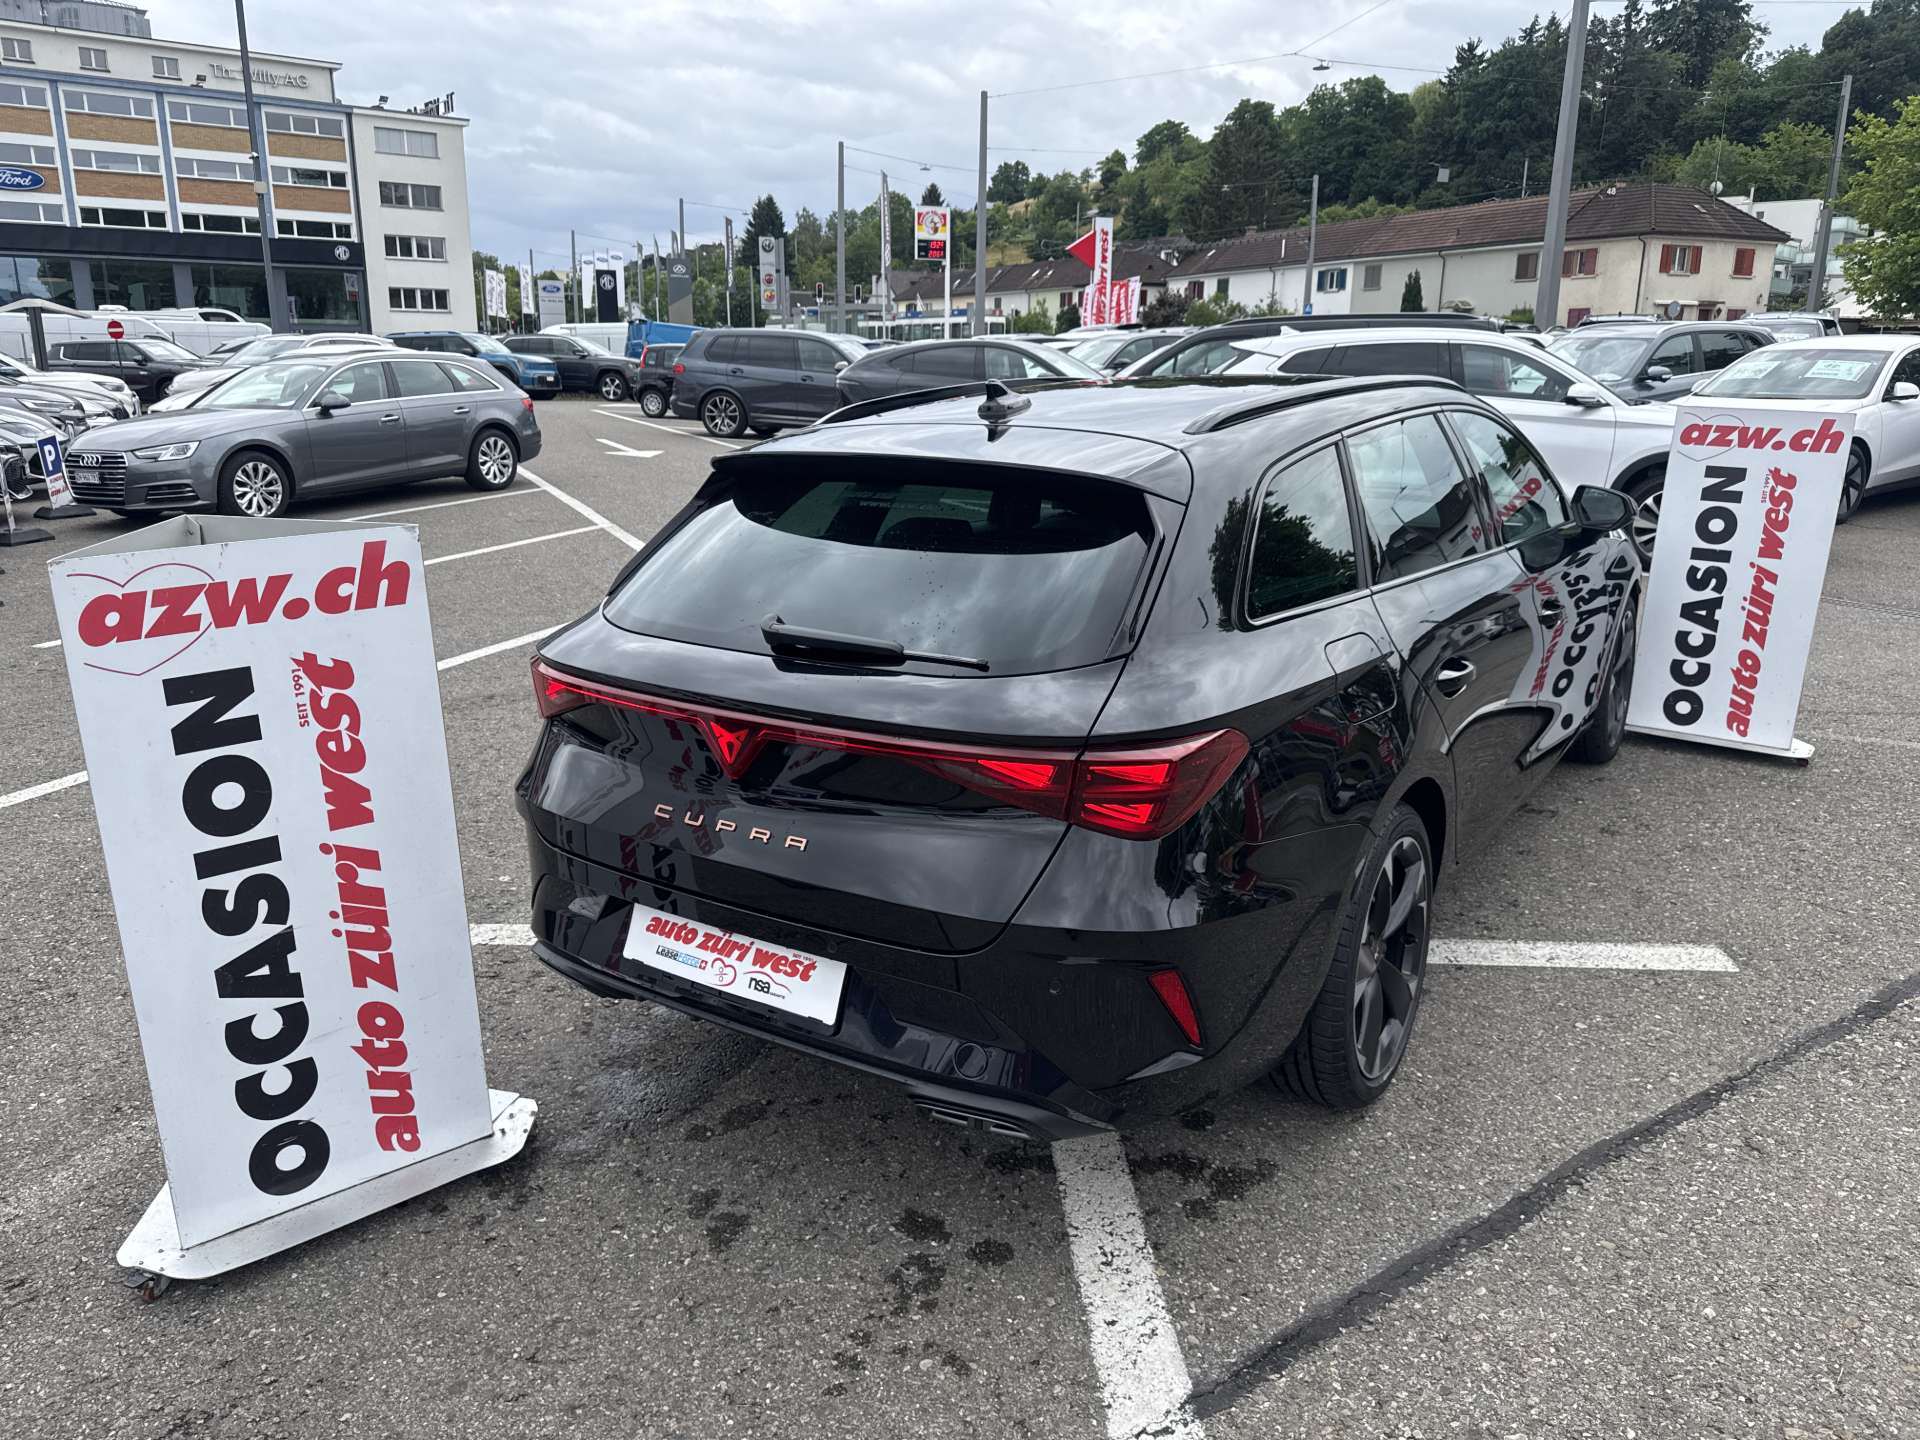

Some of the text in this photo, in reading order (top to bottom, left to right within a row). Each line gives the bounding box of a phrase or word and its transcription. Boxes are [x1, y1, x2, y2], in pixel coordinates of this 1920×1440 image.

[284, 75, 309, 88] AG
[0, 170, 33, 186] Ford
[600, 274, 615, 290] MG
[43, 444, 56, 471] P
[1679, 419, 1845, 455] azw.ch
[78, 540, 411, 647] azw.ch
[1663, 465, 1748, 726] OCCASION
[1726, 467, 1798, 737] auto züri west
[291, 668, 309, 727] SEIT 1991
[654, 804, 808, 851] CUPRA
[290, 651, 421, 1153] auto züri west
[162, 666, 330, 1196] OCCASION
[645, 916, 817, 982] auto züri west
[748, 976, 771, 995] nsa
